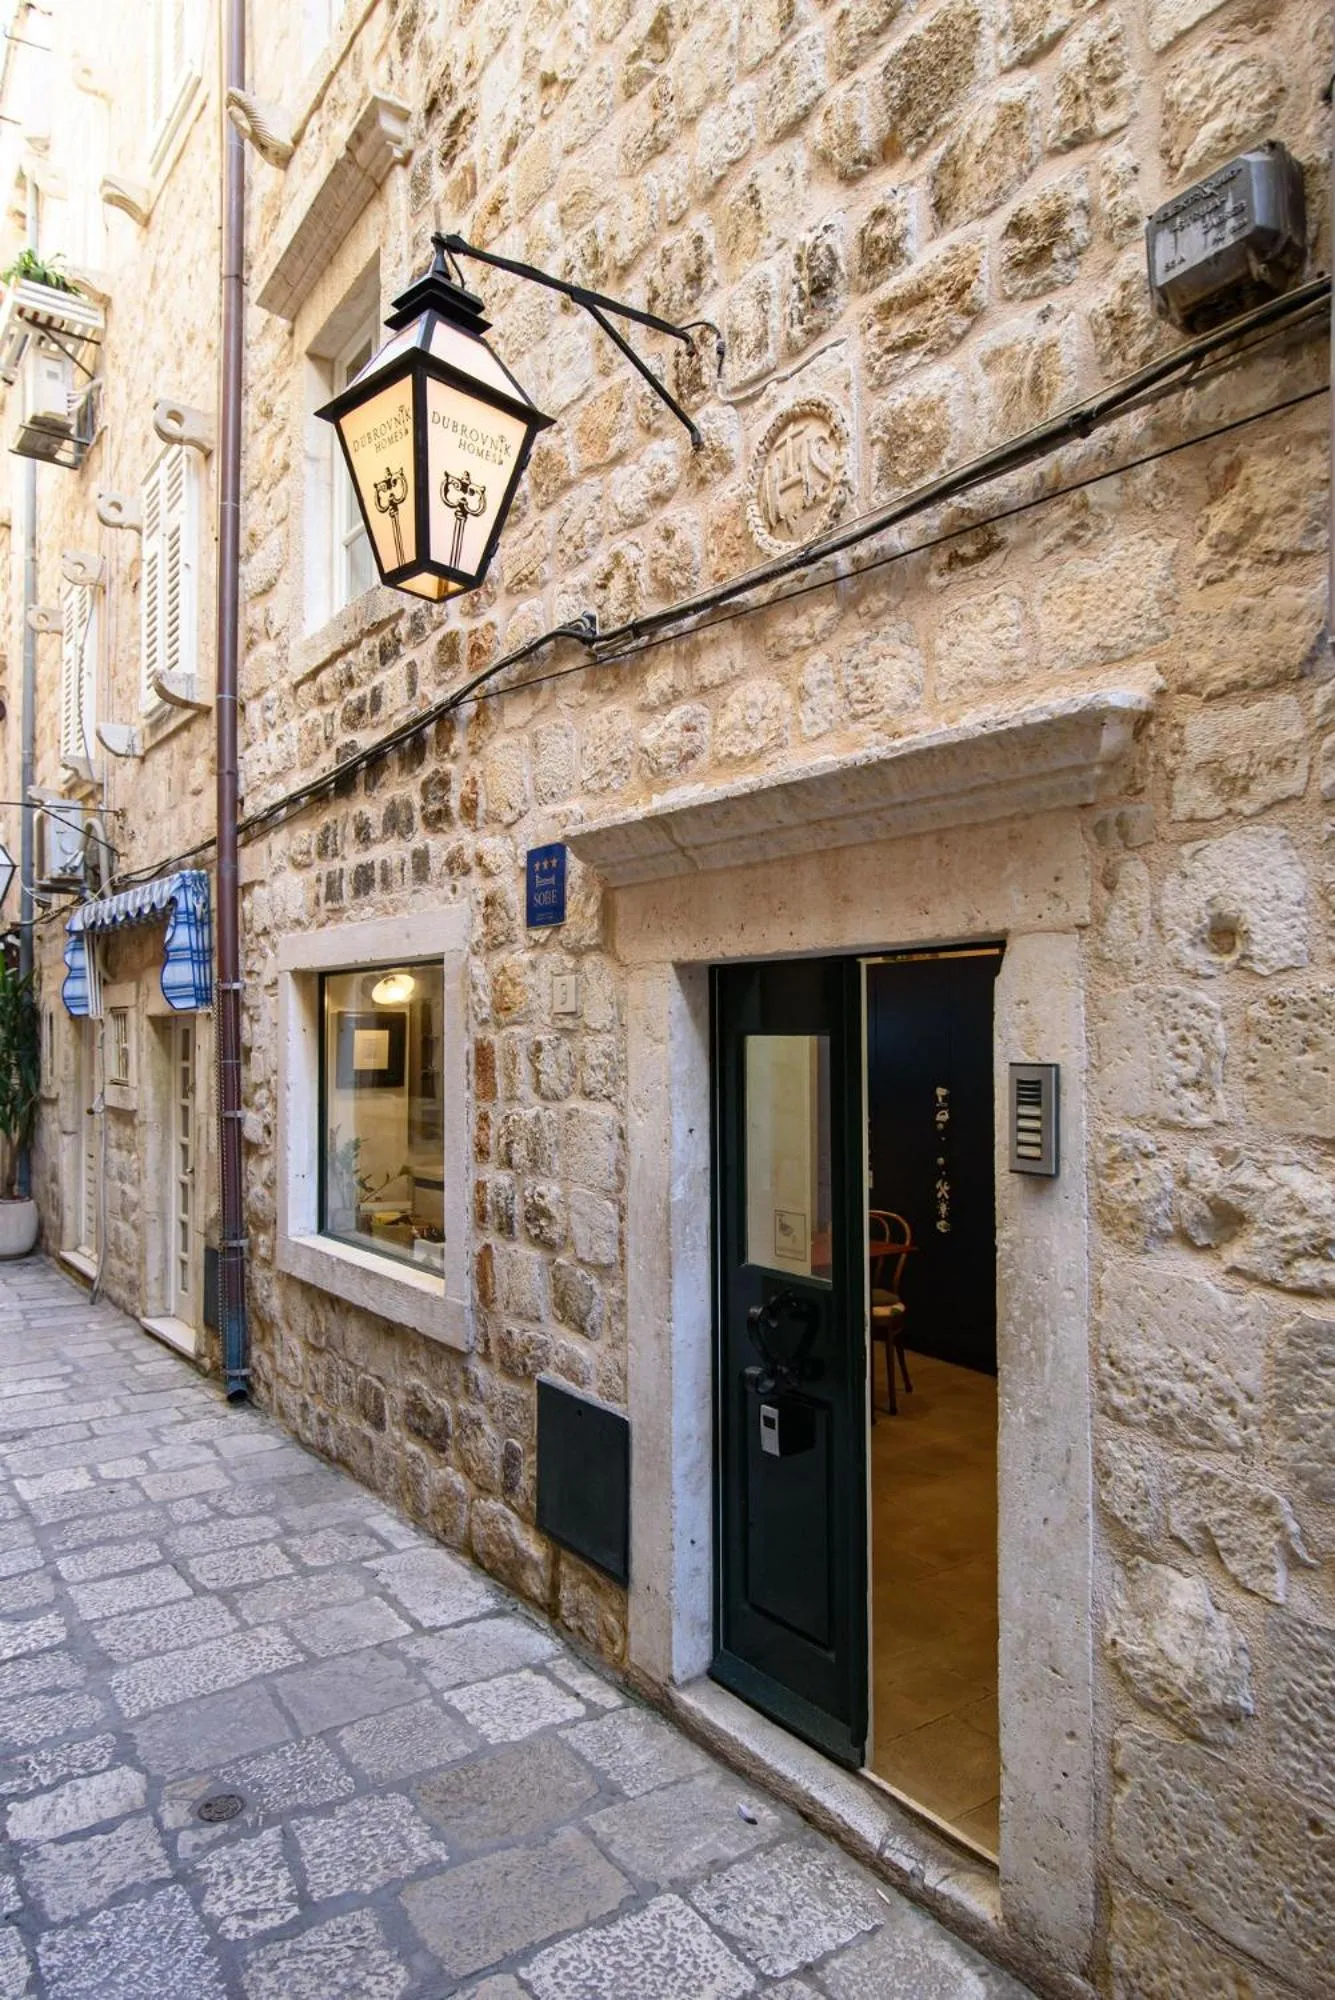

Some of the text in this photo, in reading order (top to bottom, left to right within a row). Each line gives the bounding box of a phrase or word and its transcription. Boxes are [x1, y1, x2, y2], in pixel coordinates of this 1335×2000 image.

[352, 405, 412, 453] DUBROVNIK
[374, 429, 404, 454] HOMES
[431, 410, 512, 457] DUBROVNIK
[458, 438, 498, 464] HOMES
[533, 888, 558, 907] SOBE
